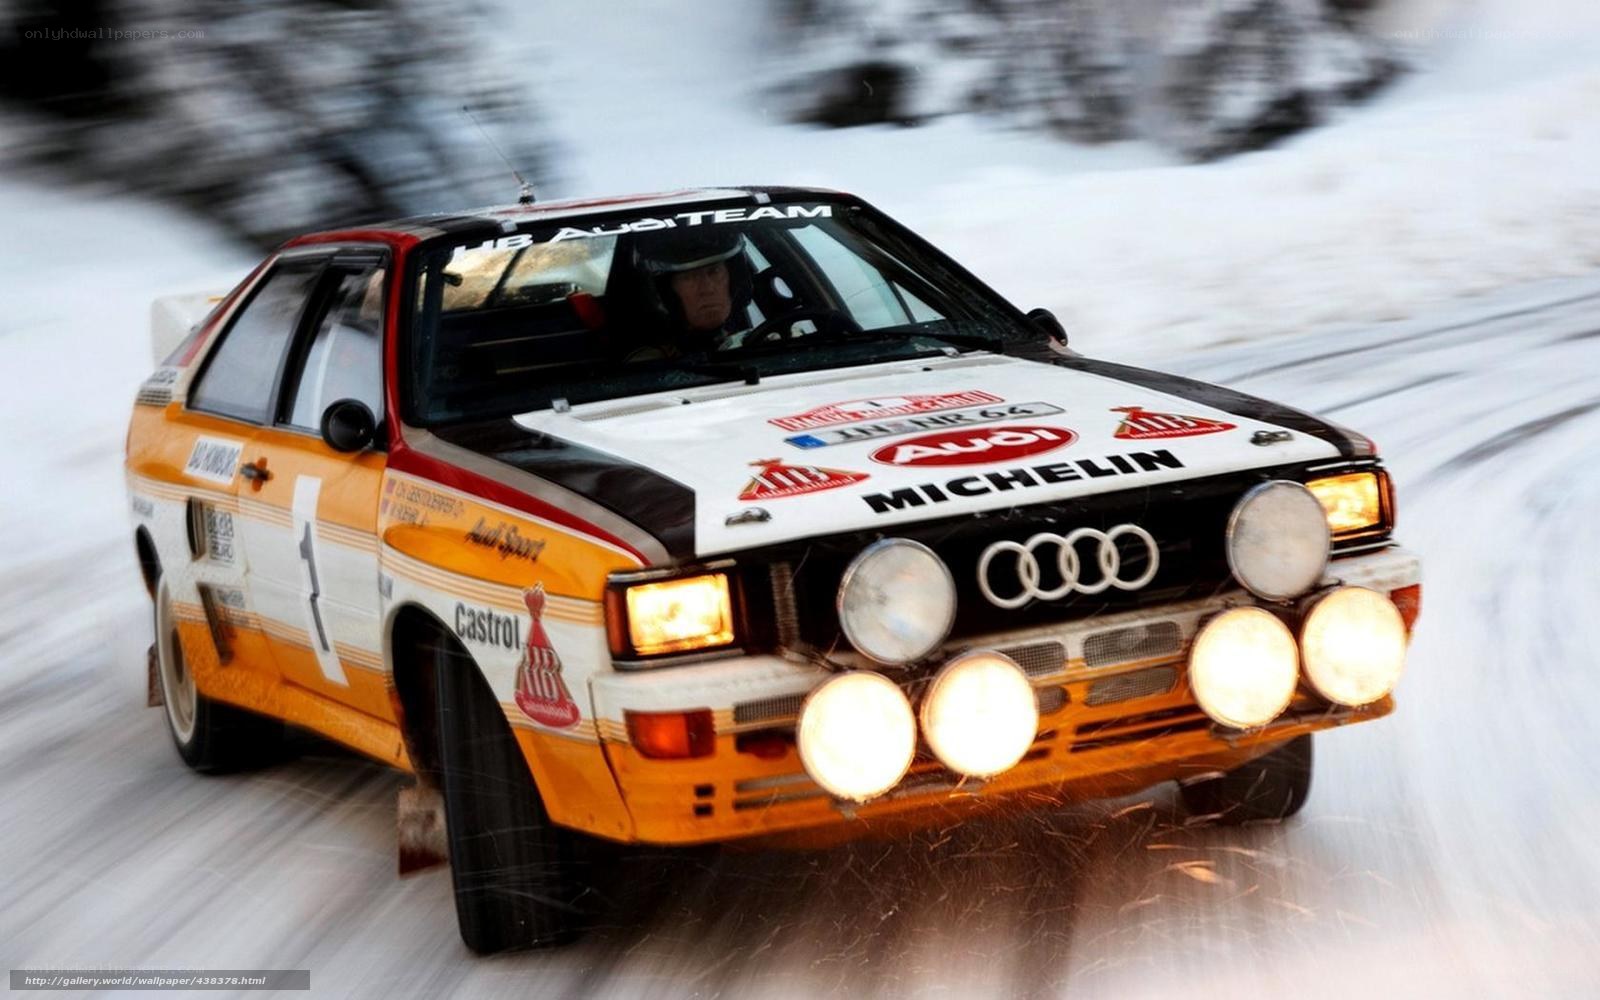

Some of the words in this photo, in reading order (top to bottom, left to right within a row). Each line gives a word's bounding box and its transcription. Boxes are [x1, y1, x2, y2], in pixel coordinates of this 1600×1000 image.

[676, 205, 832, 226] TEAM
[980, 404, 1034, 419] 64
[862, 449, 1184, 514] MICHELIN
[454, 601, 521, 650] Castrol
